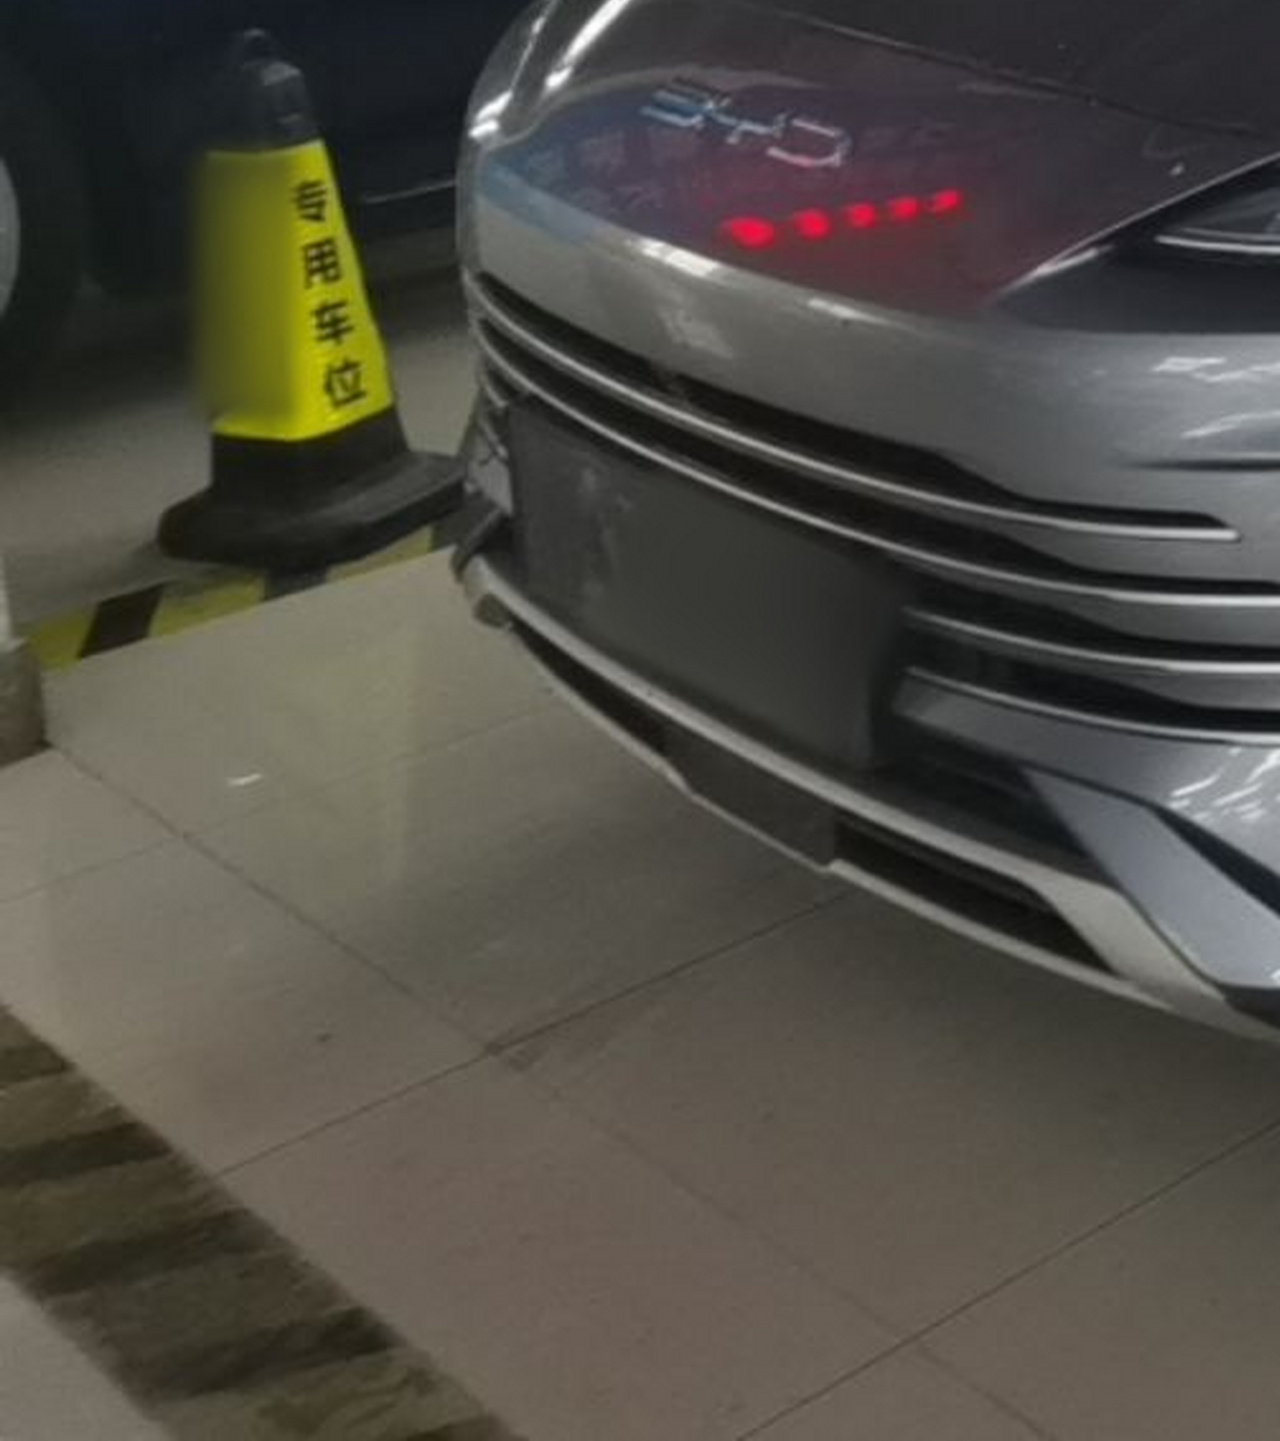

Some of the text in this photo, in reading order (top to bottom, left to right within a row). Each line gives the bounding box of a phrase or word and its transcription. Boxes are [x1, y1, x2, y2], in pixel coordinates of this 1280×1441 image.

[641, 83, 852, 166] BYD
[293, 179, 367, 408] 专用车位
